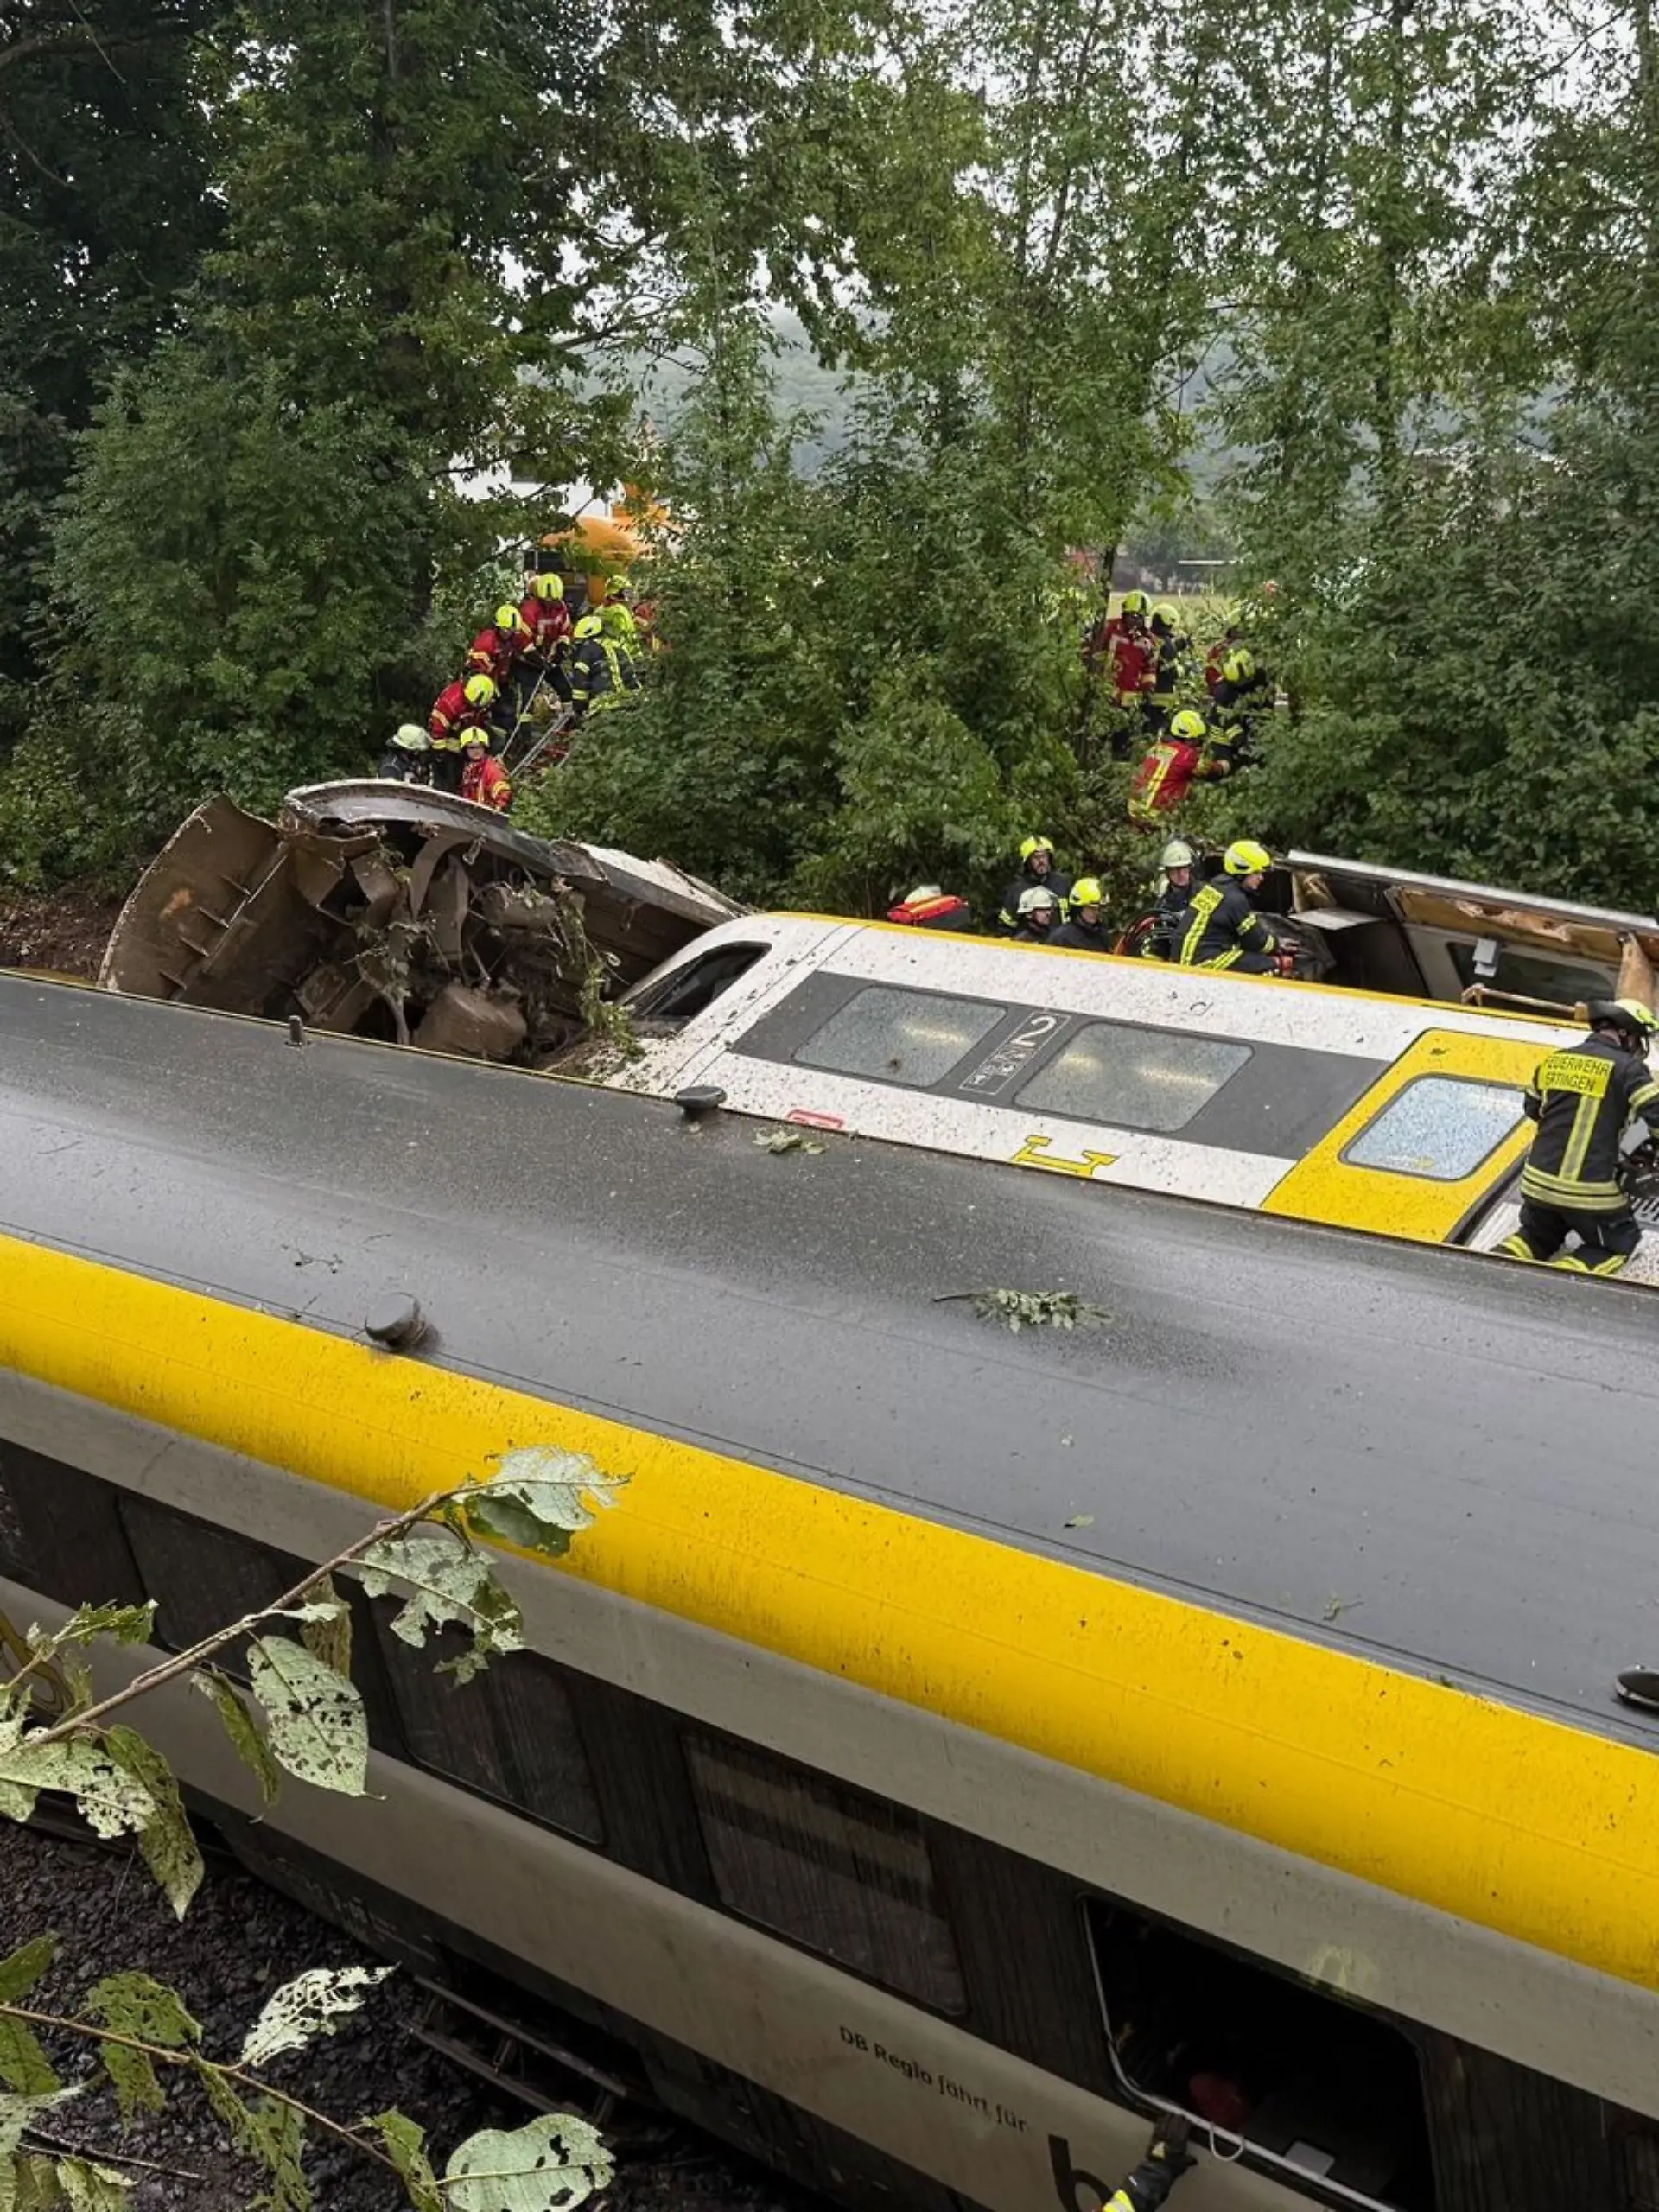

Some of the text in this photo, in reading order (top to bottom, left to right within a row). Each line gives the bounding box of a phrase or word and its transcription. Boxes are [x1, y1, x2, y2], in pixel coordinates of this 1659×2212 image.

[1010, 1015, 1057, 1047] 2
[1545, 1055, 1610, 1076] FEUERWEHR
[839, 2025, 869, 2052] DB
[874, 2042, 933, 2085] Regio
[995, 2103, 1028, 2133] für
